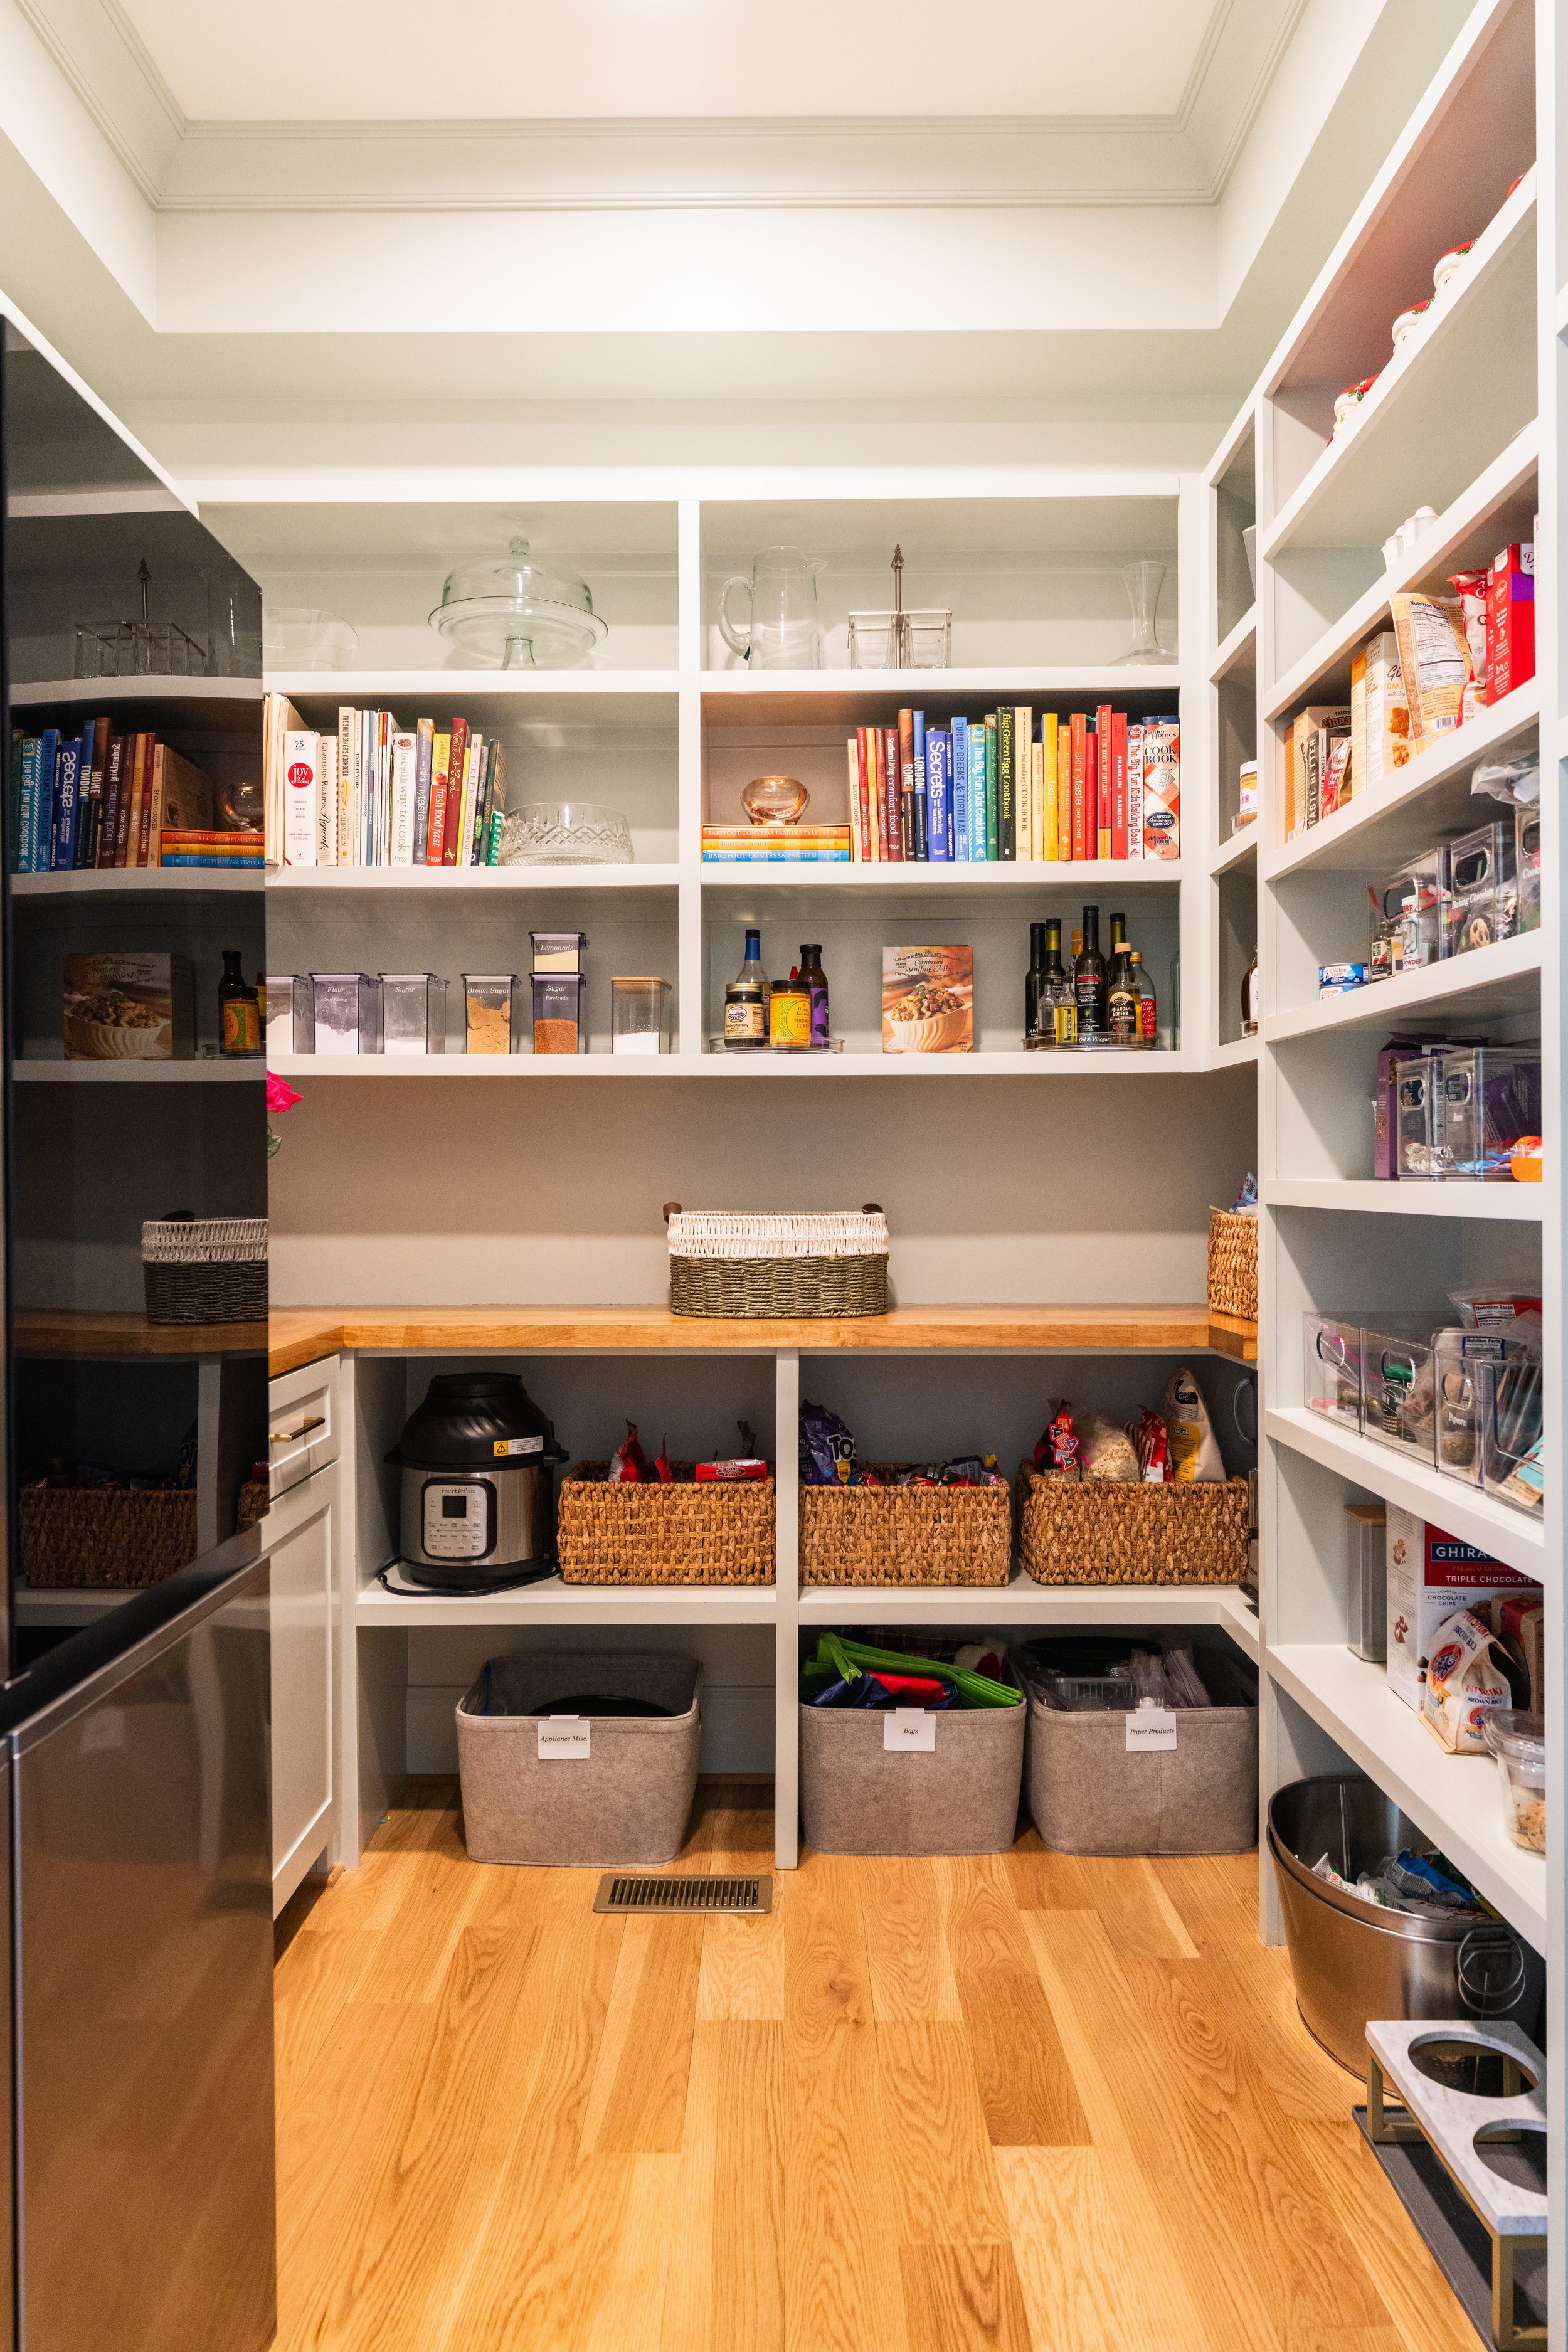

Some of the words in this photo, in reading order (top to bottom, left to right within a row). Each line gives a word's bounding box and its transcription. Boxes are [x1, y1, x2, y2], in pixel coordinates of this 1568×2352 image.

[1001, 714, 1010, 728] Big
[956, 721, 964, 750] TURNIP
[1002, 729, 1011, 756] Green
[1131, 744, 1140, 757] The
[1144, 746, 1177, 755] COOK
[1145, 755, 1177, 764] BOOK
[291, 765, 309, 784] joy
[903, 764, 913, 787] ROME
[914, 756, 925, 789] LONDON
[930, 741, 946, 798] Secrets
[956, 751, 965, 780] GREENS
[972, 760, 982, 775] Big,
[1001, 758, 1010, 775] Egg
[1128, 759, 1140, 771] Big,
[468, 760, 477, 795] GREEK
[975, 776, 983, 790] Fun
[1047, 752, 1056, 805] skinnytaste
[1074, 751, 1084, 805] skinnytaste
[1131, 773, 1140, 785] Fun
[399, 785, 407, 808] way
[416, 766, 427, 820] skinnytaste
[435, 788, 446, 808] fresh
[888, 778, 898, 813] comfort
[975, 791, 985, 807] Kids
[1131, 788, 1140, 802] Kids
[399, 809, 408, 822] to
[433, 809, 445, 827] food
[465, 795, 474, 828] COOKERY
[1128, 804, 1140, 827] Baking
[889, 814, 899, 835] food
[975, 808, 985, 845] Cookbook
[398, 823, 410, 852] cook
[432, 825, 444, 847] fast
[1131, 829, 1140, 845] Book
[1147, 835, 1172, 845] Meredith
[1452, 897, 1469, 909] Baking
[1470, 888, 1494, 903] Chocolate
[905, 965, 932, 973] Stuffing
[1448, 1412, 1466, 1427] Popcorn
[1453, 1624, 1467, 1643] BROWN
[1466, 1638, 1478, 1651] RICE
